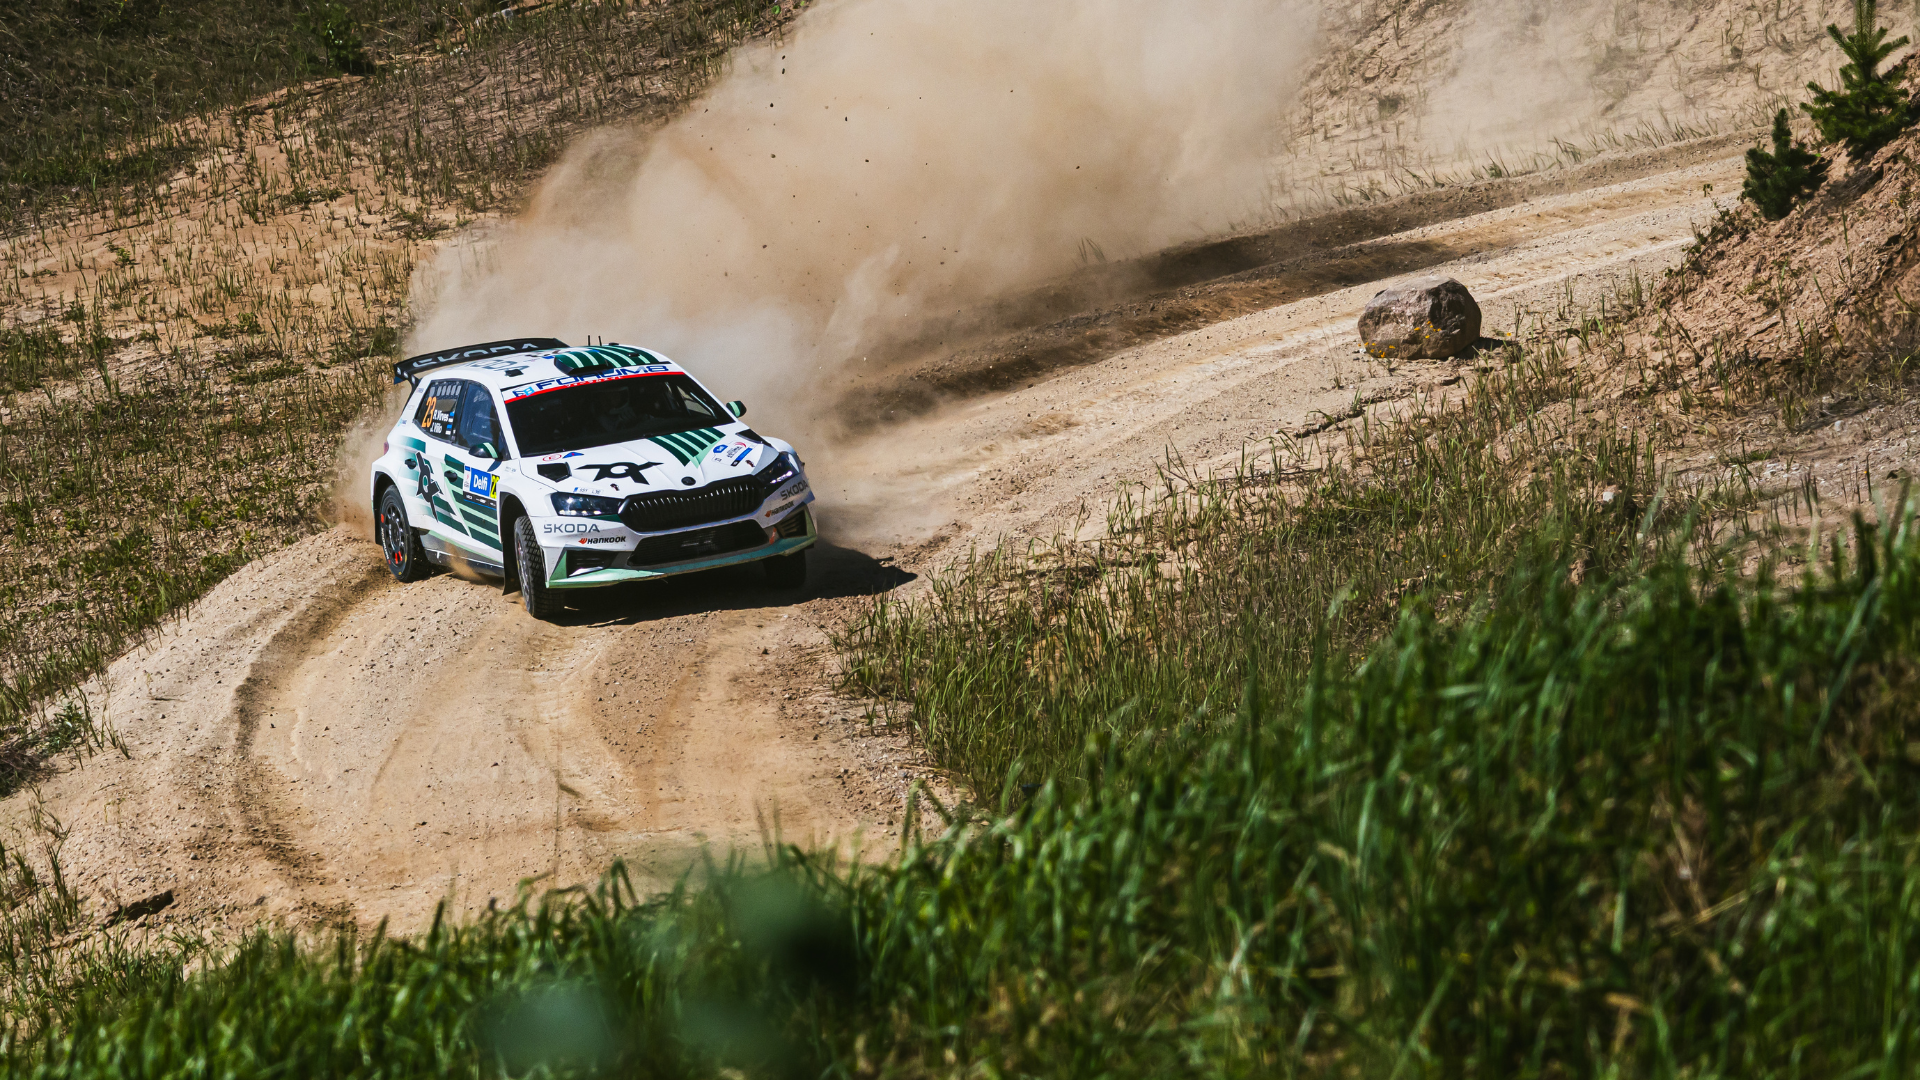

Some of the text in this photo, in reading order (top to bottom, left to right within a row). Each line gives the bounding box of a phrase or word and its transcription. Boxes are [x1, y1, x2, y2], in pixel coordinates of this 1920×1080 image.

[421, 396, 437, 428] 23
[473, 474, 488, 491] Delfi
[780, 480, 809, 501] SKODA
[543, 523, 601, 534] SKODA
